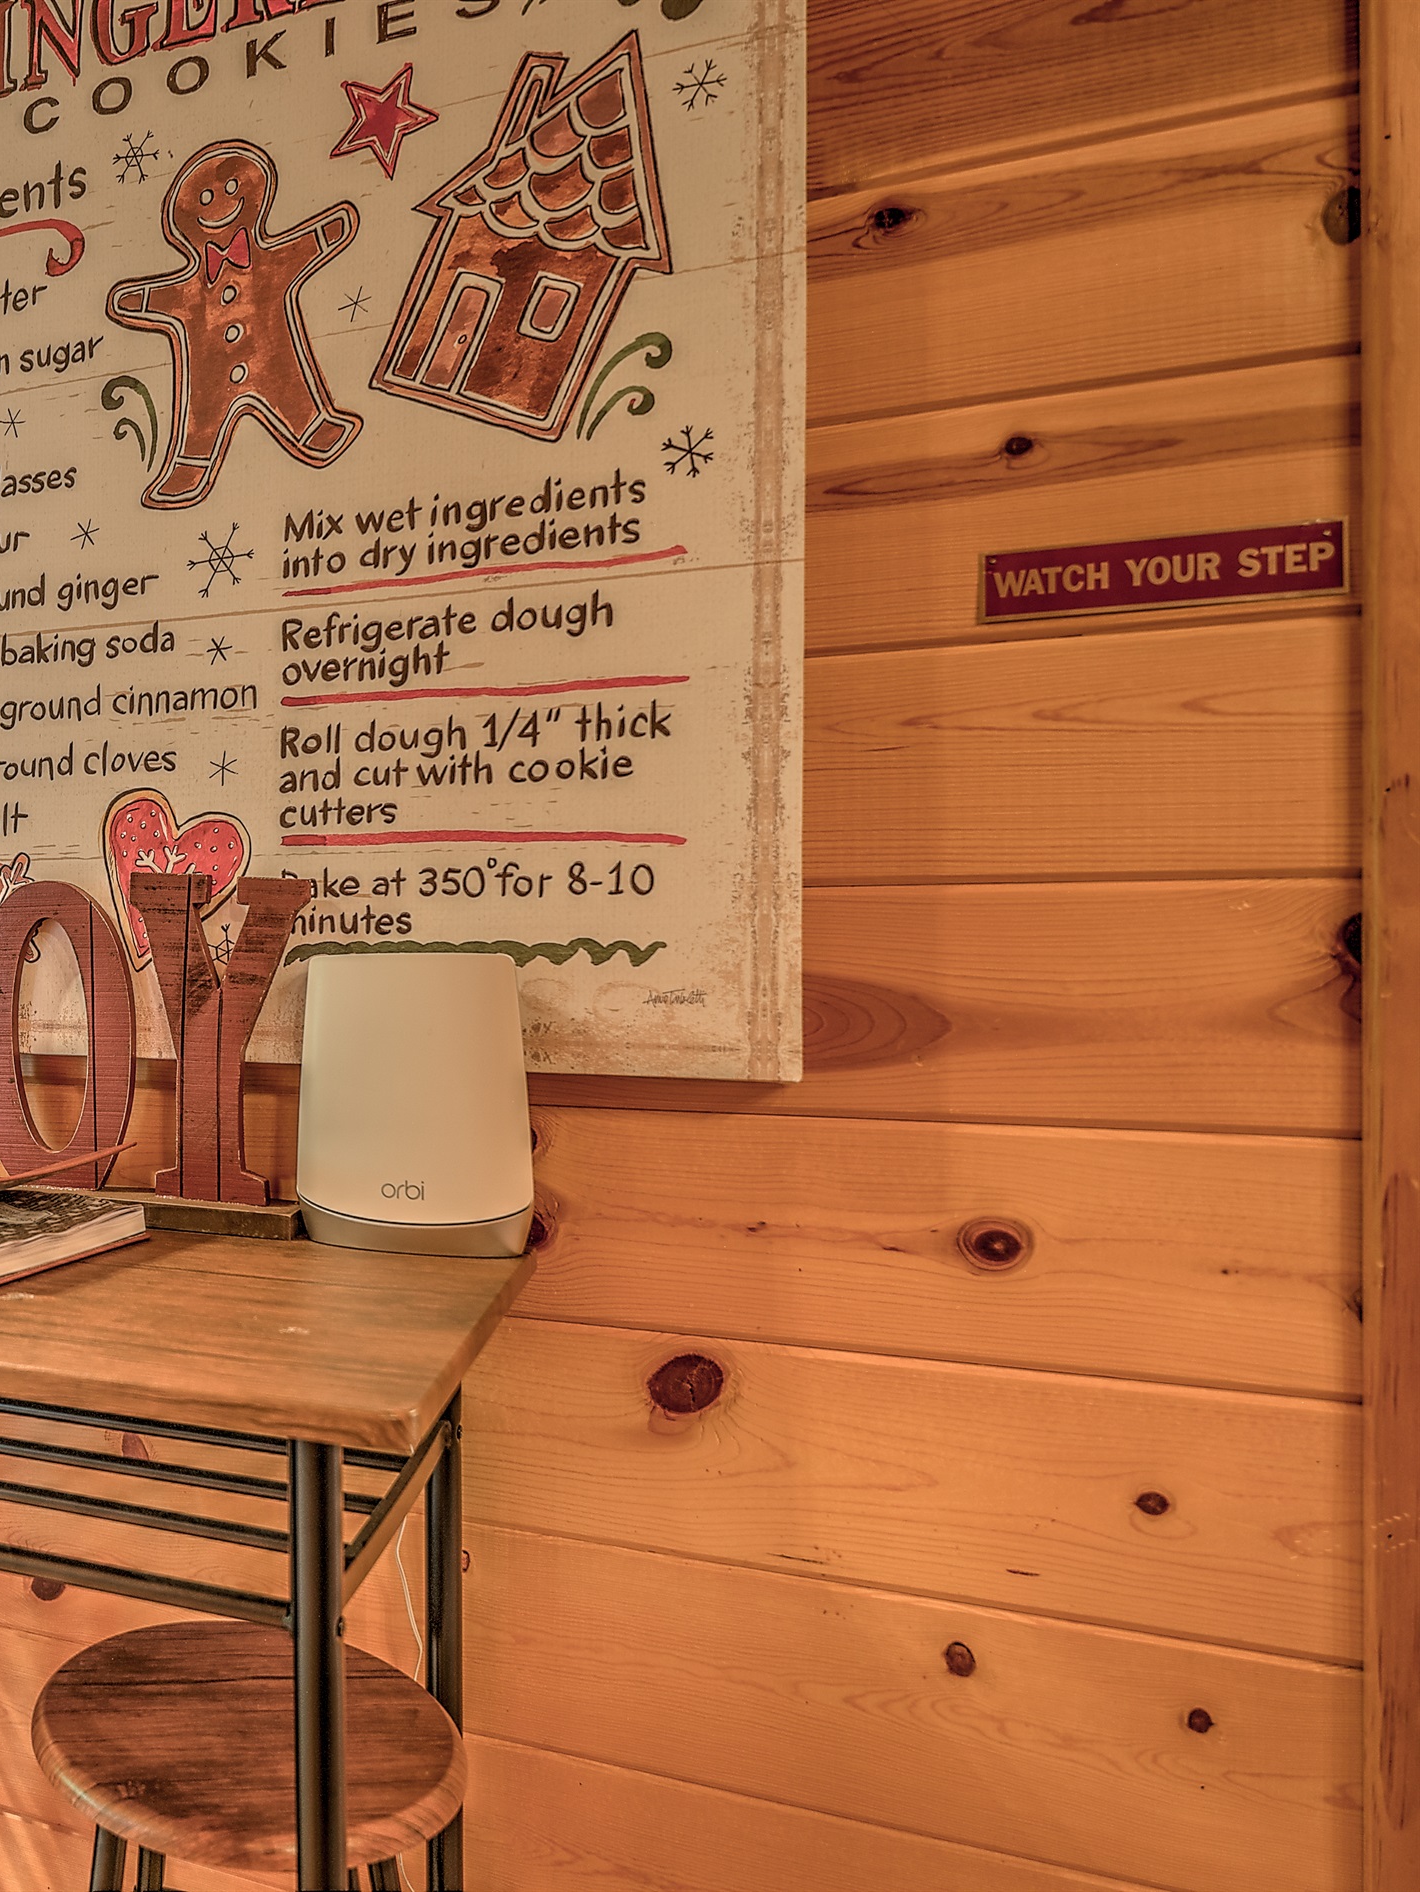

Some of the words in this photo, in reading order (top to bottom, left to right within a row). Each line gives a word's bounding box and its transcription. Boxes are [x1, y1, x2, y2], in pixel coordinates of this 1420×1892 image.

[19, 335, 104, 374] sugar
[284, 508, 344, 543] Mix
[354, 496, 423, 535] wet
[430, 468, 647, 531] ingredients
[282, 546, 346, 580] into
[359, 536, 417, 577] dry
[427, 512, 642, 569] ingredients
[993, 562, 1110, 598] WATCH
[1124, 551, 1222, 587] YOUR
[1236, 541, 1335, 578] STEP
[57, 572, 160, 612] ginger
[0, 631, 97, 668] baking
[105, 619, 175, 660] soda
[281, 603, 477, 653] Refrigerate
[490, 588, 614, 638] dough
[281, 639, 451, 688] overnight
[0, 682, 101, 731] ground
[112, 684, 257, 717] cinnamon
[280, 722, 341, 760] Roll
[354, 714, 467, 759] dough
[574, 698, 672, 743] thick
[83, 739, 177, 777] cloves
[278, 755, 341, 794] and
[353, 757, 409, 788] cut
[416, 749, 493, 787] with
[508, 745, 634, 784] cookie
[279, 796, 398, 829] cutters
[371, 867, 408, 898] at
[494, 862, 553, 898] for
[565, 860, 656, 897] 8-10
[381, 1179, 424, 1201] orbi
